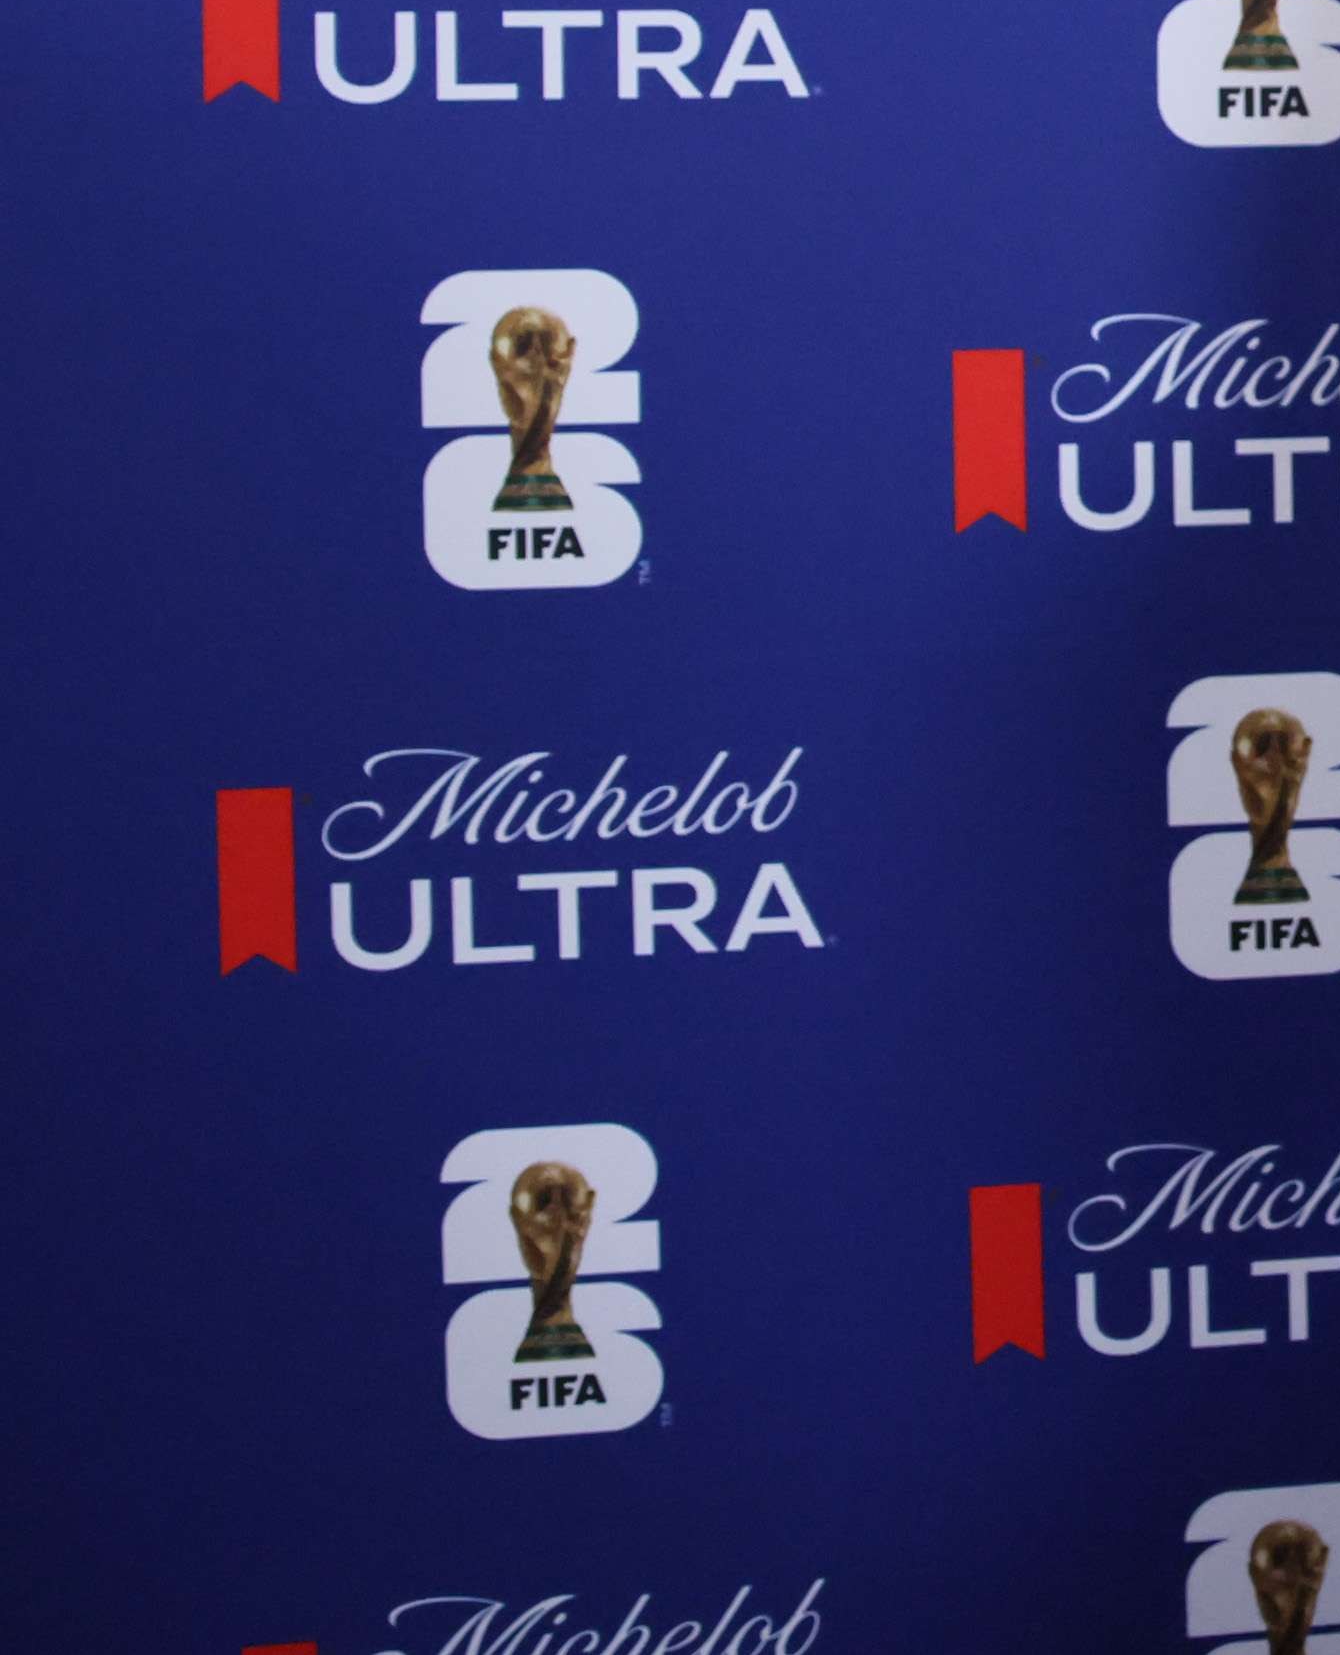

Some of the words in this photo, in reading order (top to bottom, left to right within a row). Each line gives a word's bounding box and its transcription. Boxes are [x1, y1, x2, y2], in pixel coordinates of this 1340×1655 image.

[315, 9, 809, 104] ULTRA
[1220, 87, 1308, 117] FIFA
[489, 527, 584, 560] FIFA
[322, 747, 803, 860] Michelob
[331, 863, 824, 970] ULTRA
[1231, 918, 1319, 951] FIFA
[511, 1374, 606, 1410] FIFA
